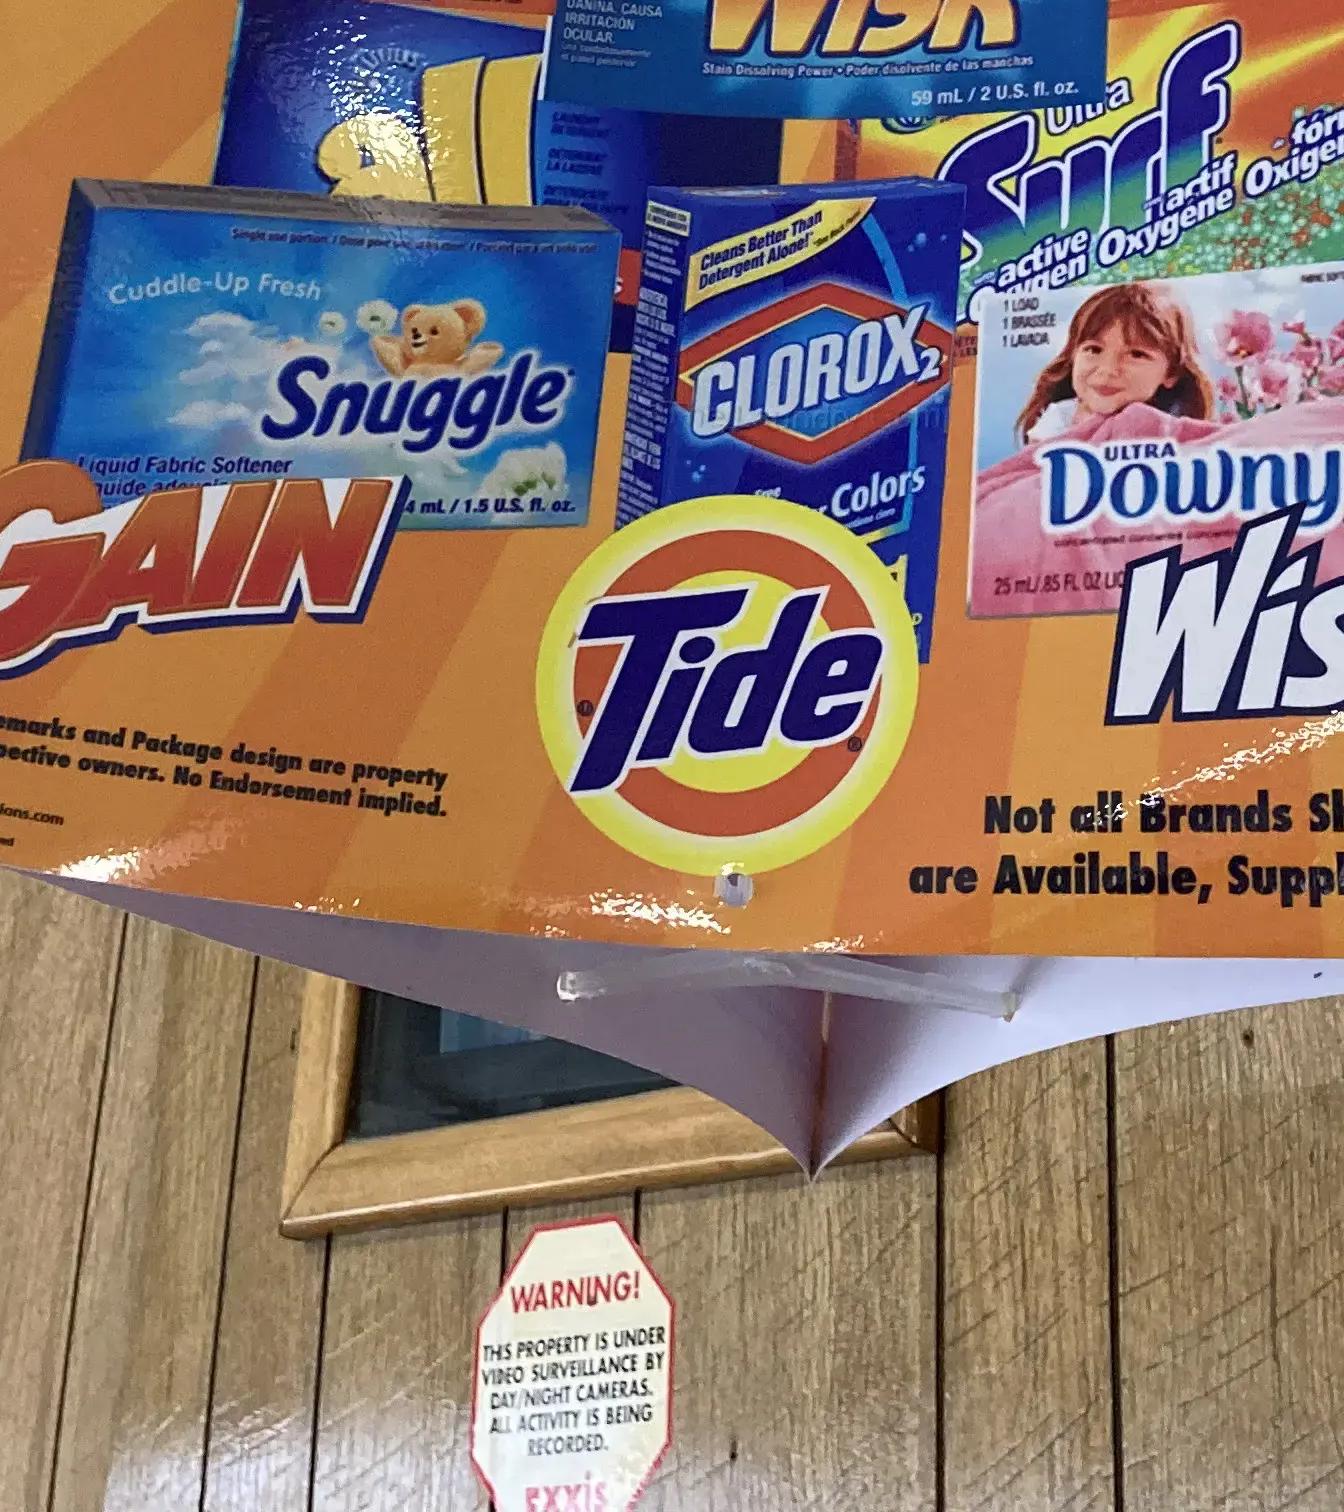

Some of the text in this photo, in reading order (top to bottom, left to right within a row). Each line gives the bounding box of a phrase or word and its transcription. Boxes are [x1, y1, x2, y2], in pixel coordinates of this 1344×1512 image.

[621, 3, 663, 18] CAUSA
[702, 56, 1034, 79] Stain Dissolving Power Poder disolvente de las manchas
[911, 81, 1079, 105] 59 mL 2 U.S. fl. oz.
[701, 242, 745, 271] Cleans
[748, 228, 789, 253] Better
[791, 210, 823, 235] Than
[998, 230, 1089, 288] active
[108, 271, 321, 305] Cuddle-Up Fresh
[699, 252, 764, 289] Detergent
[260, 352, 570, 453] Snuggle
[78, 456, 293, 476] Liquid Fabric Softener
[1103, 443, 1175, 461] ULTRA
[420, 497, 576, 514] mL 1.5 U.S. fl. oz.
[831, 466, 926, 518] Colors
[1041, 447, 1344, 528] Downy
[569, 581, 884, 797] Tide
[82, 727, 127, 748] and
[131, 730, 222, 764] Package
[230, 743, 303, 774] design
[309, 758, 347, 775] are
[352, 762, 448, 792] property
[77, 757, 165, 783] owners.
[173, 766, 203, 787] No
[209, 770, 352, 806] Endorsement
[358, 788, 448, 817] implied.
[983, 795, 1055, 834] Not
[1070, 791, 1123, 834] all
[1140, 789, 1293, 834] Brands
[909, 864, 979, 895] are
[992, 851, 1212, 905] Available,
[483, 1326, 666, 1363] THIS PROPERTY IS UNDER
[482, 1351, 665, 1386] VIDEO SURVEILLANCE BY
[490, 1386, 571, 1410] DAY/NIGHT
[489, 1403, 653, 1434] ALL ACTIVITY IS BEING
[528, 1433, 609, 1457] RECORDED.
